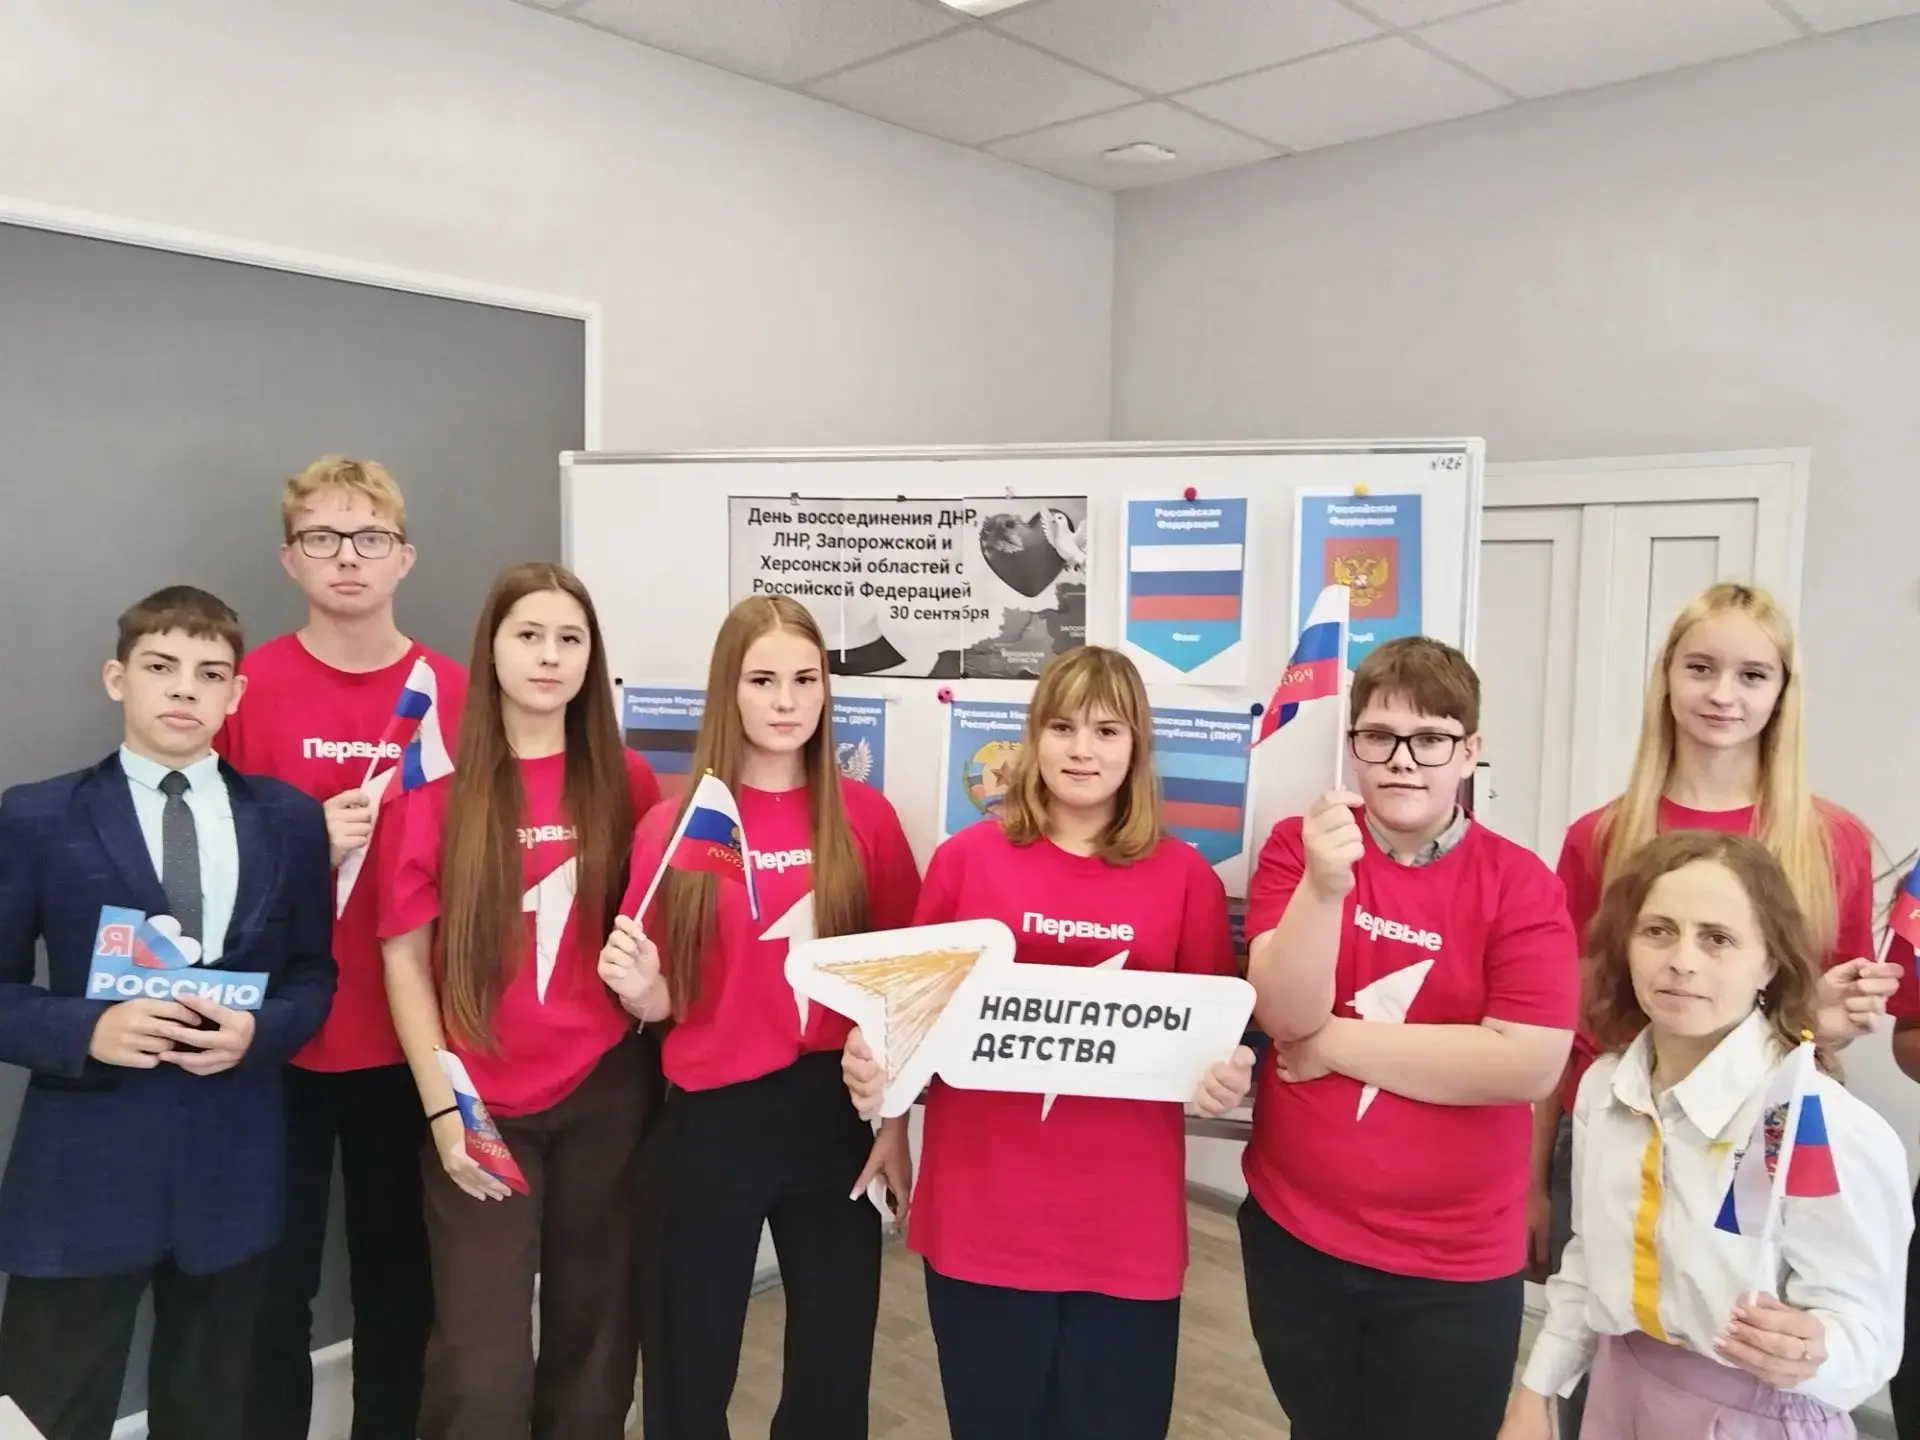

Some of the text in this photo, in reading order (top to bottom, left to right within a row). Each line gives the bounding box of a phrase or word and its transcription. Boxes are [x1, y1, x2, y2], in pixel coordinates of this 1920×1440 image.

[748, 507, 979, 529] День воссоединения ДНР,
[773, 532, 953, 553] ЛНР, Запорожской и
[867, 558, 950, 575] областей
[955, 562, 964, 575] с
[859, 581, 972, 602] Федерацией
[889, 603, 990, 623] 30 сентября
[303, 737, 402, 764] Первые
[96, 923, 135, 958] Я
[1022, 911, 1135, 943] Первые
[91, 971, 260, 1006] РОССИЮ
[979, 995, 1192, 1032] НАВИГАТОРЫ
[971, 1032, 1117, 1065] ДЕТСТВА
